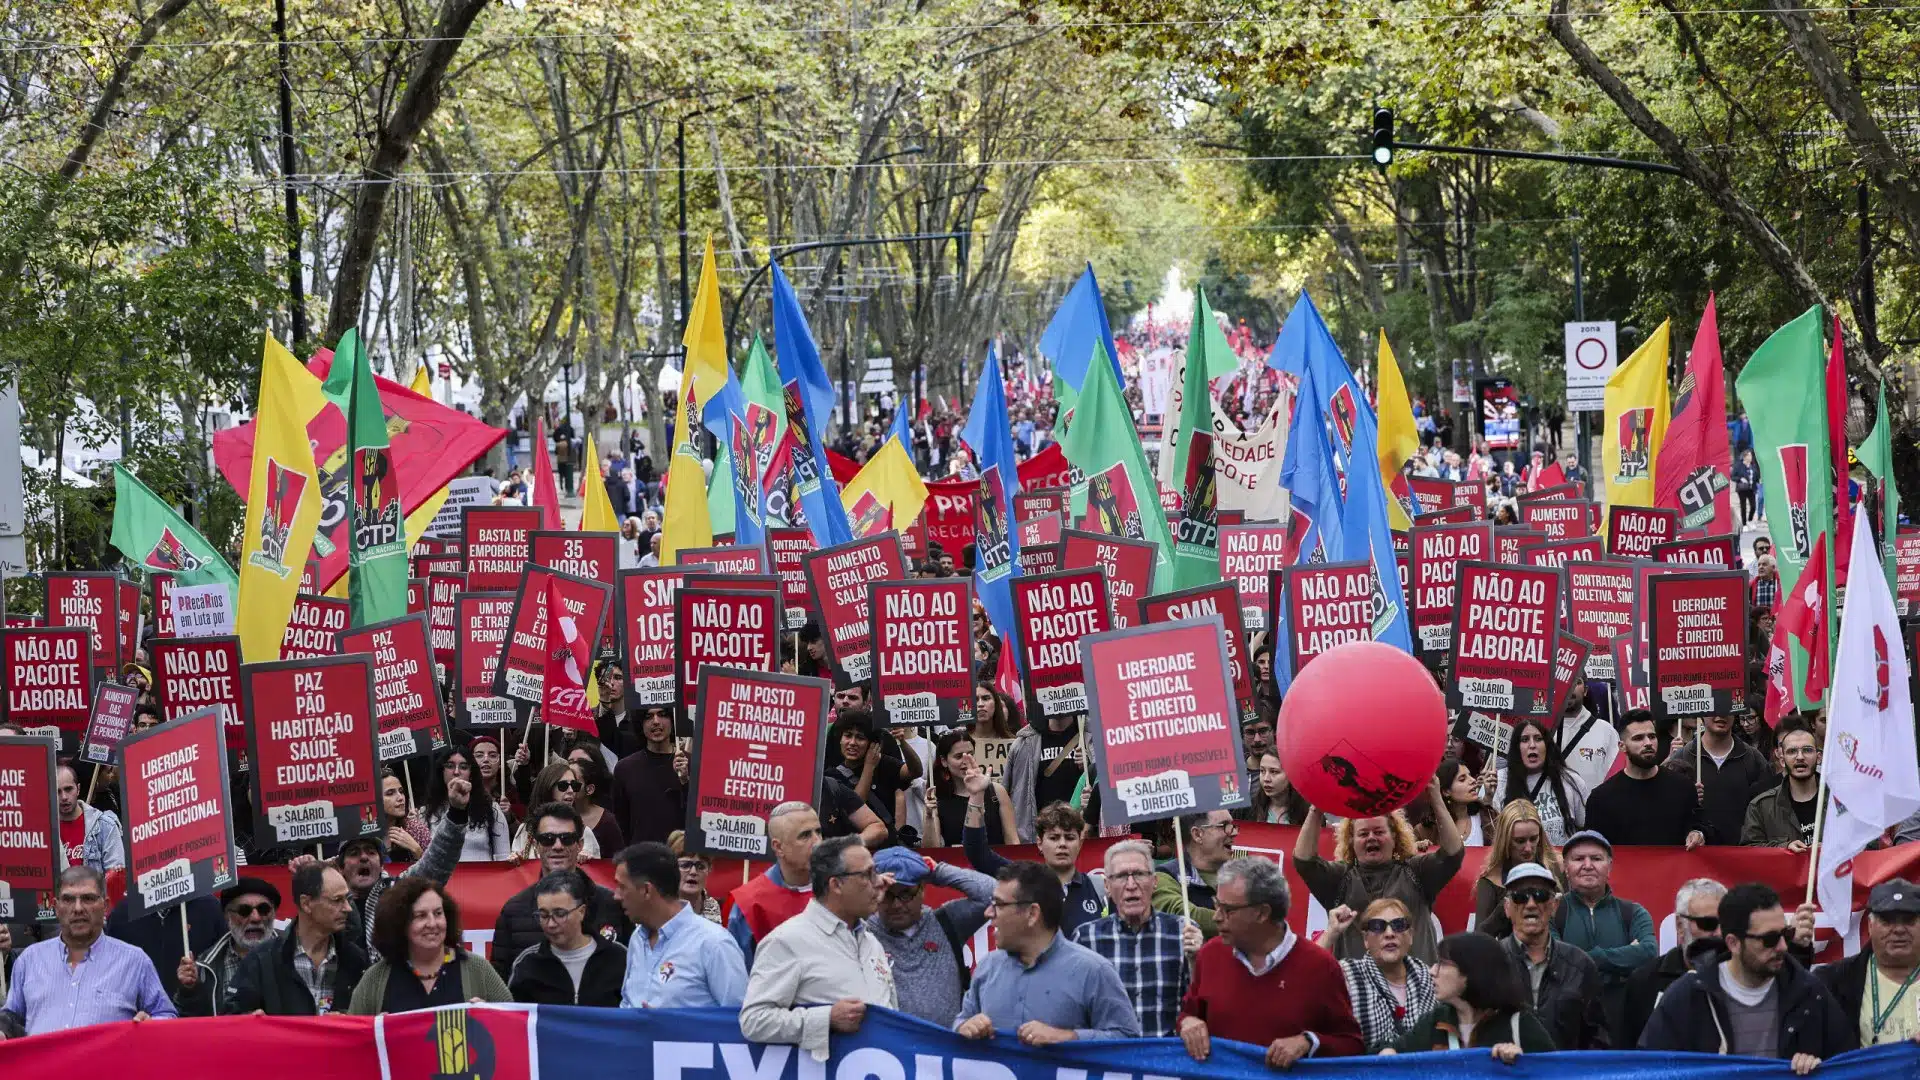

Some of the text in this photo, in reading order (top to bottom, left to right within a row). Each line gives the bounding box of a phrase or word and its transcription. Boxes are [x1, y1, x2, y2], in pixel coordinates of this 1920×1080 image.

[1024, 499, 1052, 510] DIREITO
[1456, 496, 1470, 506] DAS
[1530, 507, 1578, 522] AUMENTO
[1620, 512, 1666, 532] NÃO AO
[480, 529, 526, 542] BASTA DE
[1026, 524, 1039, 534] PAZ
[1545, 523, 1565, 536] DAS
[564, 540, 584, 558] 35
[1027, 534, 1040, 546] PÃO
[1228, 532, 1282, 552] NÃO AO
[1422, 534, 1456, 559] NÃO
[1459, 534, 1480, 556] AO
[1501, 539, 1518, 550] PAZ
[470, 544, 529, 558] EMPOBRECE
[827, 546, 881, 572] AUMENTO
[1096, 544, 1120, 561] PAZ
[1501, 550, 1518, 564] PÃO
[1535, 548, 1593, 568] NÃO AO
[1666, 548, 1724, 564] NÃO AO
[469, 560, 524, 573] A TRABALH
[550, 560, 598, 579] HORAS
[1226, 554, 1284, 573] PACOTE
[828, 562, 888, 590] GERAL DOS
[1573, 574, 1632, 590] CONTRATAÇÃO
[72, 579, 88, 596] 35
[434, 579, 449, 604] NÃO
[788, 581, 806, 594] NÃO!
[1301, 572, 1370, 600] NÃO AO
[1472, 572, 1544, 606] NÃO AO
[178, 593, 224, 611] PRecáRios
[886, 590, 956, 618] NÃO AO
[1027, 581, 1094, 614] NÃO AO
[1572, 588, 1634, 604] COLETIVA, SIM!
[1672, 597, 1727, 614] LIBERDADE
[60, 597, 102, 615] HORAS
[479, 602, 514, 615] UM POS
[692, 599, 762, 629] NÃO AO
[1302, 600, 1374, 628] PACOTE
[65, 616, 98, 632] PARA
[180, 612, 225, 628] em Luta por
[289, 602, 345, 630] NÃO AO
[471, 616, 483, 628] DE
[1030, 608, 1100, 642] PACOTE
[1468, 604, 1544, 634] PACOTE
[1578, 610, 1633, 626] CADUCIDADE,
[1677, 614, 1722, 628] SINDICAL
[636, 613, 675, 642] 105
[886, 620, 960, 648] PACOTE
[1597, 626, 1617, 638] NÃO!
[1677, 628, 1724, 644] É DIREITO
[372, 630, 394, 648] PAZ
[691, 632, 764, 658] PACOTE
[1459, 632, 1548, 664] LABORAL
[15, 636, 50, 662] NÃO
[55, 638, 78, 660] AO
[376, 647, 397, 665] PÃO
[1658, 644, 1740, 661] CONSTITUCIONAL
[164, 648, 228, 676] NÃO AO
[880, 649, 968, 676] LABORAL
[1117, 652, 1196, 680] LIBERDADE
[1589, 656, 1612, 668] SALÁRIO
[14, 663, 80, 687] PACOTE
[294, 672, 323, 692] PAZ
[167, 676, 233, 702] PACOTE
[376, 678, 410, 700] SAÚDE
[731, 683, 795, 706] UM POSTO
[1048, 688, 1078, 700] SALÁRIO
[1127, 674, 1193, 700] SINDICAL
[1472, 682, 1504, 695] SALÁRIO
[1674, 688, 1704, 700] SALÁRIO
[10, 687, 88, 712] LABORAL
[104, 690, 132, 704] AUMENTO
[296, 692, 325, 715] PÃO
[376, 693, 424, 718] DUCAÇÃO
[478, 699, 507, 710] SALÁRIO
[897, 696, 929, 708] SALÁRIO
[1053, 699, 1086, 711] DIREITOS
[1474, 694, 1509, 707] DIREITOS
[1677, 700, 1710, 712] DIREITOS
[109, 704, 120, 714] DAS
[480, 712, 512, 722] DIREITOS
[718, 701, 805, 727] DE TRABALHO
[902, 708, 936, 720] DIREITOS
[1128, 694, 1196, 721] É DIREITO
[97, 713, 128, 732] REFORMAS
[271, 713, 354, 740] HABITAÇÃO
[1106, 712, 1226, 746] CONSTITUCIONAL
[94, 726, 124, 740] E PENSÕES
[378, 732, 406, 748] SALÁRIO
[716, 720, 804, 746] PERMANENTE
[290, 735, 338, 762] SAÚDE
[382, 742, 413, 758] DIREITOS
[142, 744, 200, 780] LIBERDADE
[729, 758, 784, 782] VÍNCULO
[1114, 762, 1144, 776] OUTRO
[1145, 758, 1170, 772] RUMO
[1182, 748, 1228, 766] POSSÍVEL!
[277, 759, 355, 786] EDUCAÇÃO
[148, 770, 196, 797] SINDICAL
[724, 778, 784, 801] EFECTIVO
[1134, 776, 1179, 796] SALÁRIO
[148, 784, 198, 816] É DIREITO
[1142, 793, 1189, 812] DIREITOS
[132, 798, 220, 844] CONSTITUCIONAL
[284, 805, 325, 823] SALÁRIO
[290, 821, 333, 837] DIREITOS
[716, 818, 756, 834] SALÁRIO
[718, 835, 761, 851] DIREITOS
[150, 865, 183, 888] SALÁRIO
[154, 880, 190, 900] DIREITOS
